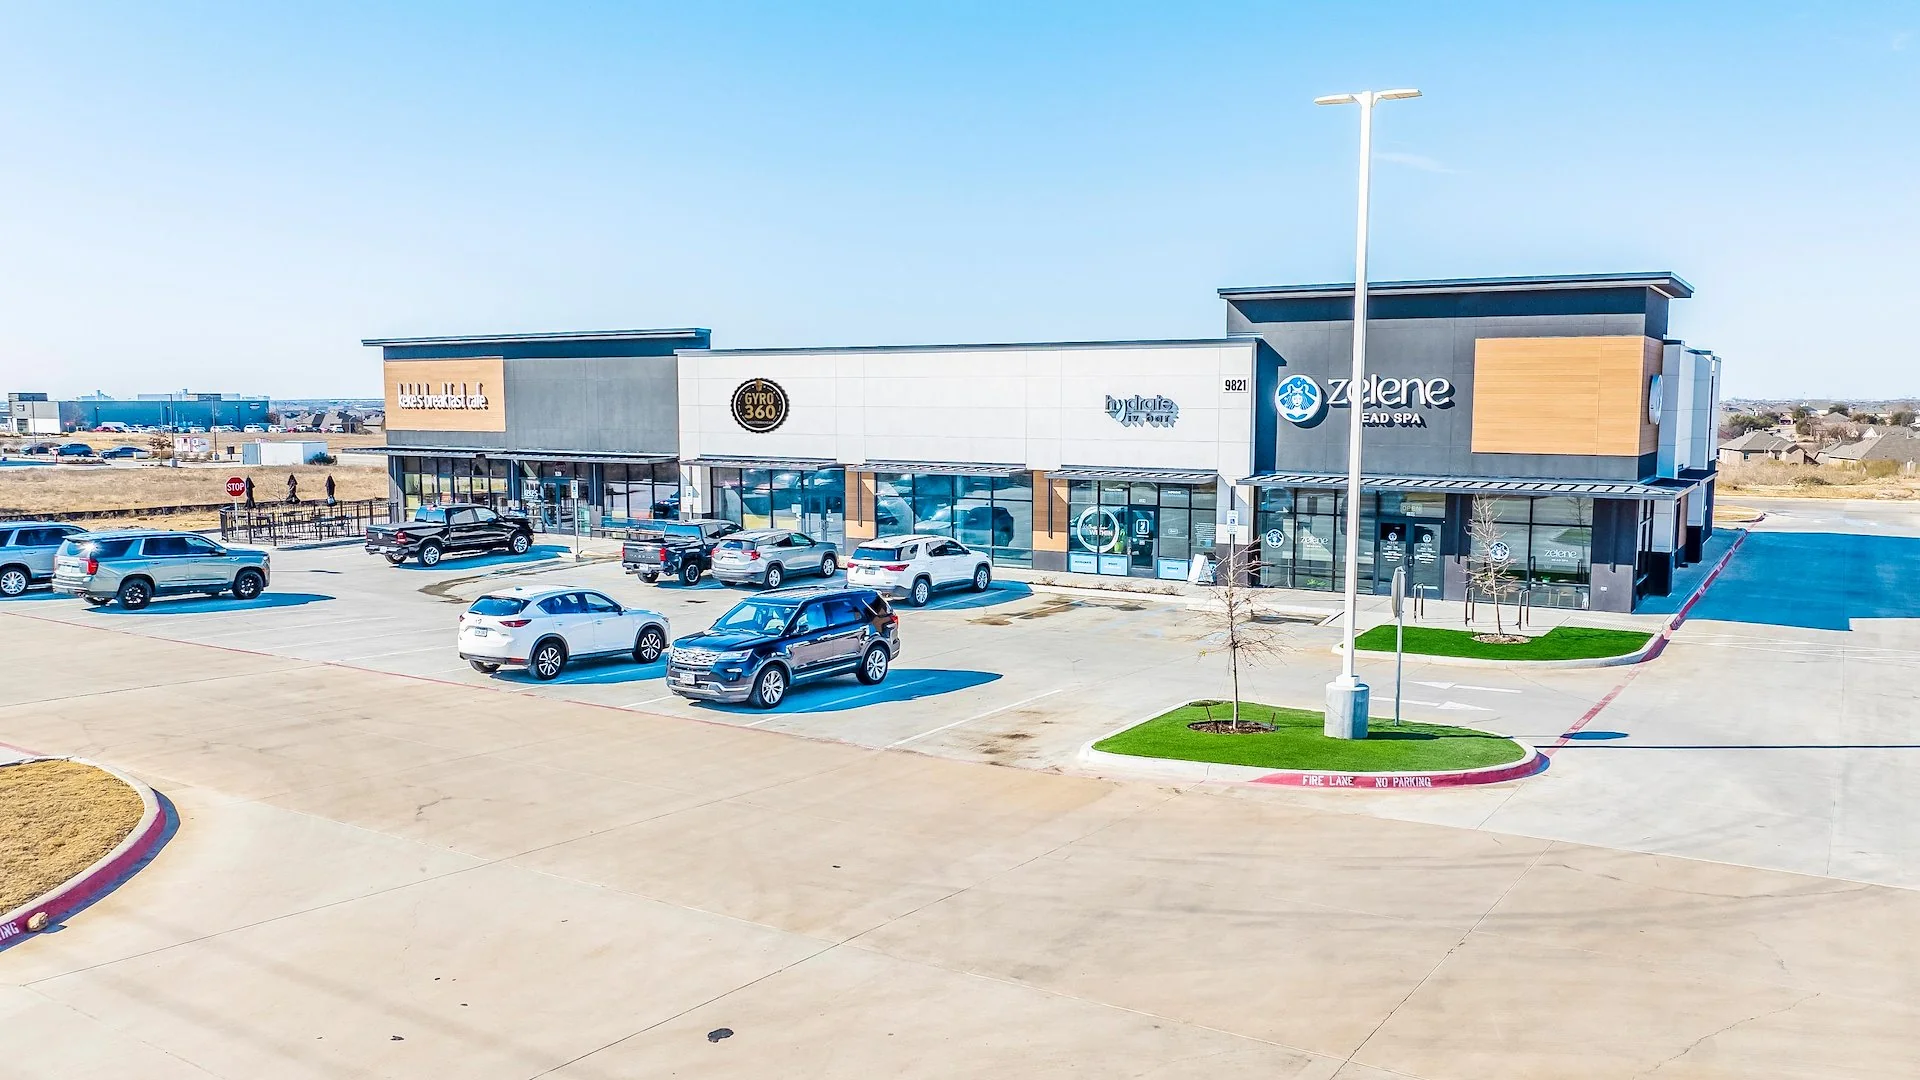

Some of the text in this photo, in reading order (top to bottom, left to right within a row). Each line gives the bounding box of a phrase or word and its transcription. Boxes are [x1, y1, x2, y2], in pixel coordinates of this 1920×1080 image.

[1224, 379, 1247, 391] 9821
[424, 382, 466, 408] breakfast
[744, 392, 774, 404] GYRO
[744, 404, 776, 419] 360
[1105, 394, 1175, 421] hydrate
[1127, 413, 1171, 422] iv bar
[1361, 413, 1421, 424] EAD SPA
[227, 482, 245, 491] STOP
[1544, 549, 1577, 558] zelene
[1302, 775, 1432, 788] FIRE LANE NO PARKING
[0, 921, 20, 941] ING
